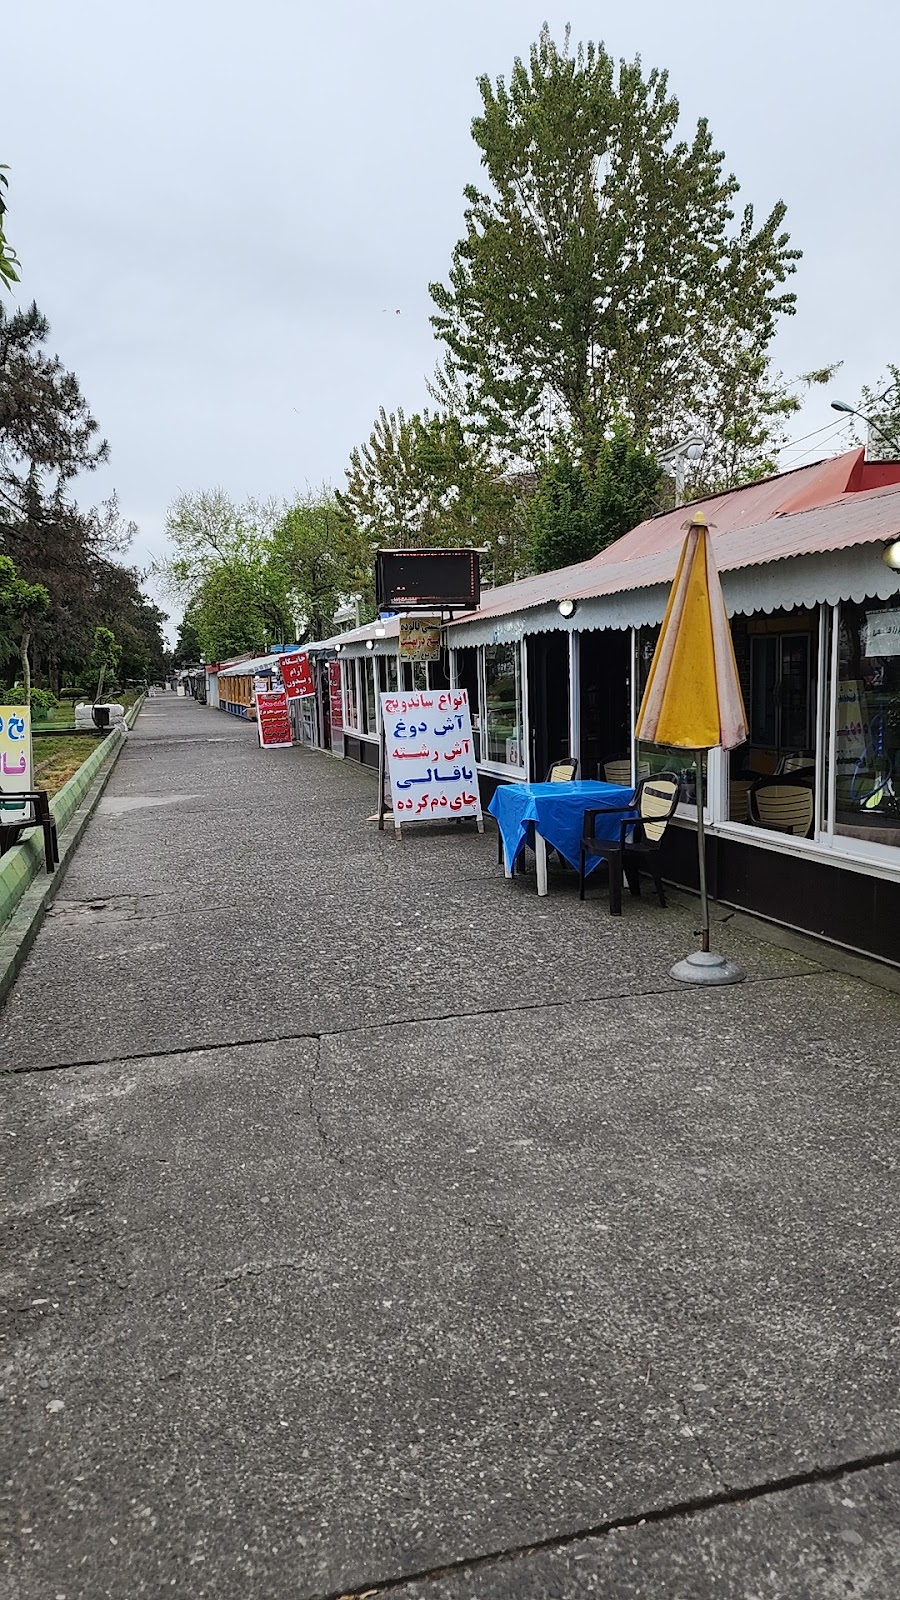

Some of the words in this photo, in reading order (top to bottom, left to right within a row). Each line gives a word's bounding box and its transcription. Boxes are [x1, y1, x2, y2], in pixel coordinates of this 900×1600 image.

[385, 693, 434, 713] ساندویچ
[438, 692, 468, 711] انواع
[8, 712, 25, 740] یخ
[393, 718, 428, 738] دوغ
[434, 714, 464, 736] آش
[392, 743, 439, 762] رشته
[443, 739, 471, 761] آش
[396, 765, 473, 789] باقالی
[396, 794, 430, 814] کرده
[449, 791, 478, 811] چای
